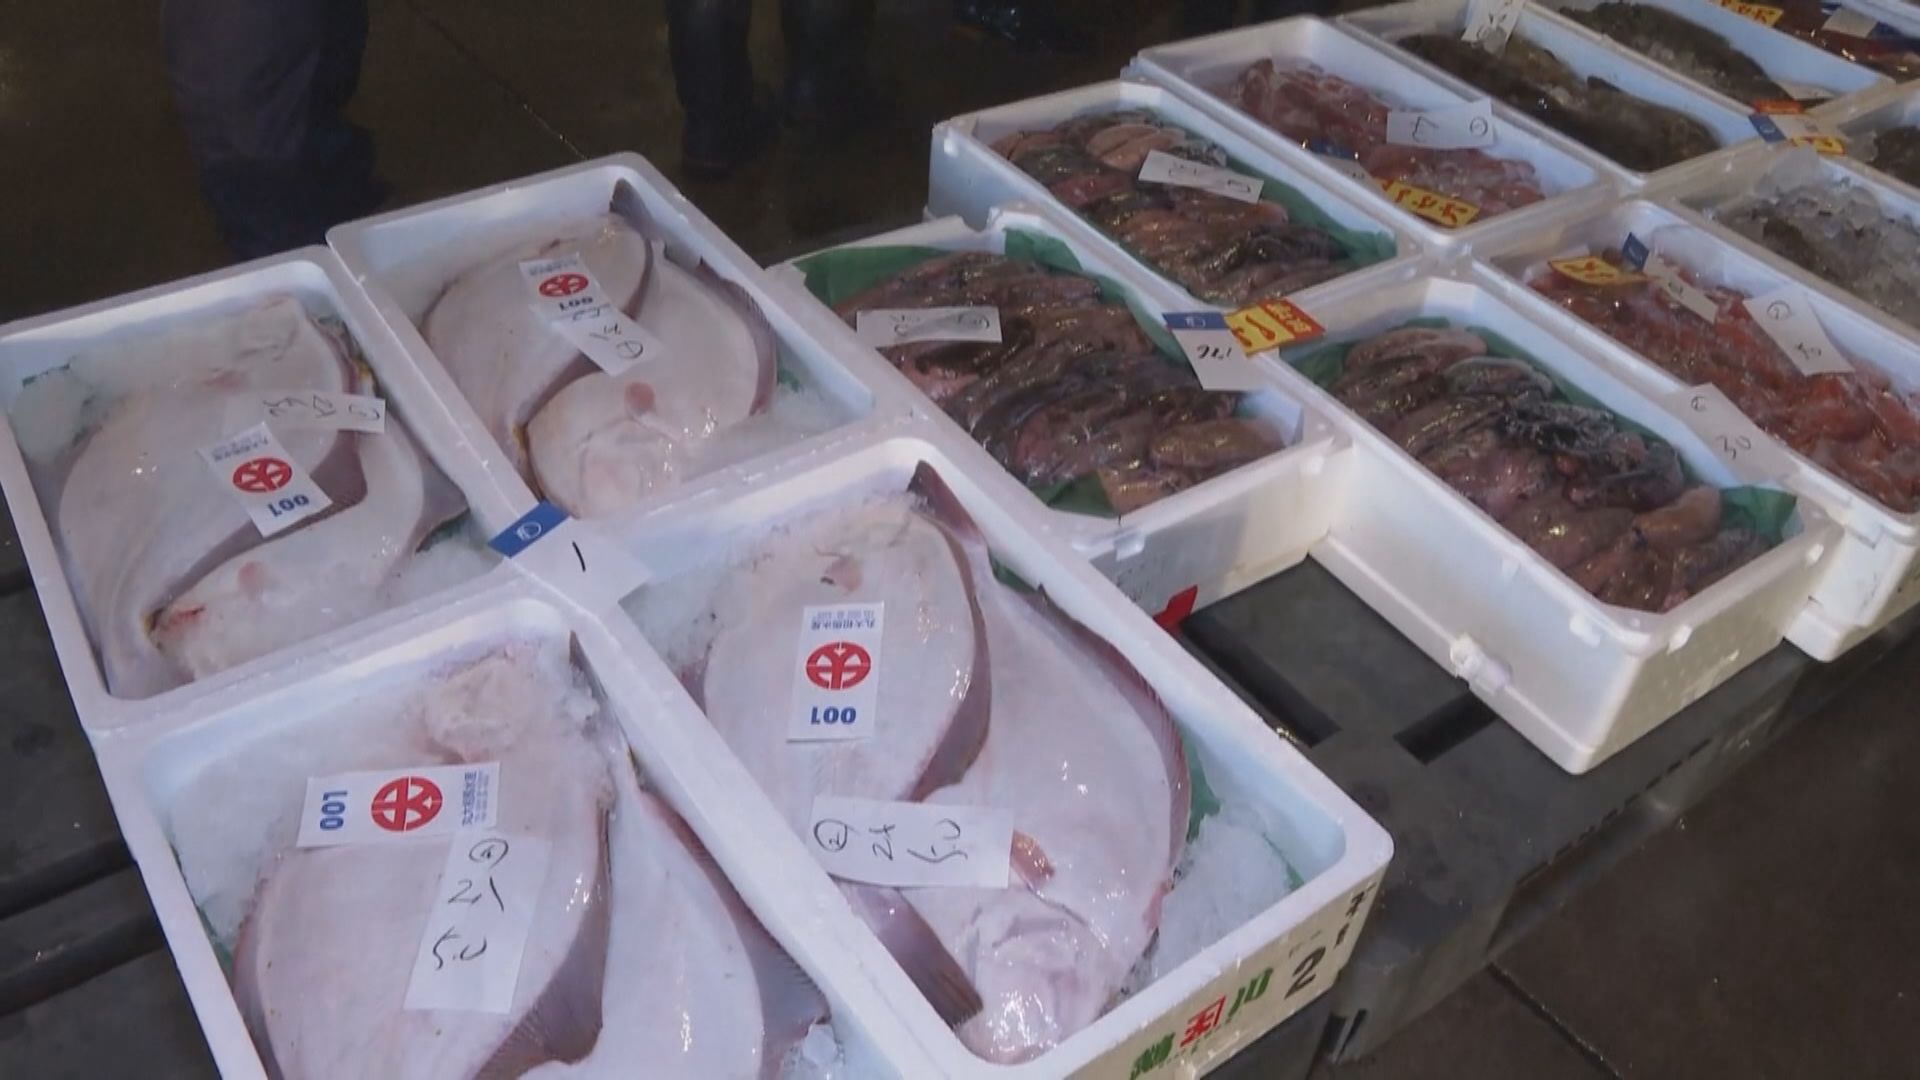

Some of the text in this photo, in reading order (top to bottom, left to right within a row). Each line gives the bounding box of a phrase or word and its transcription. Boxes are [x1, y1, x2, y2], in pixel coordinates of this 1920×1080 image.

[266, 493, 310, 518] 001
[810, 705, 857, 726] 001
[319, 789, 348, 831] 001
